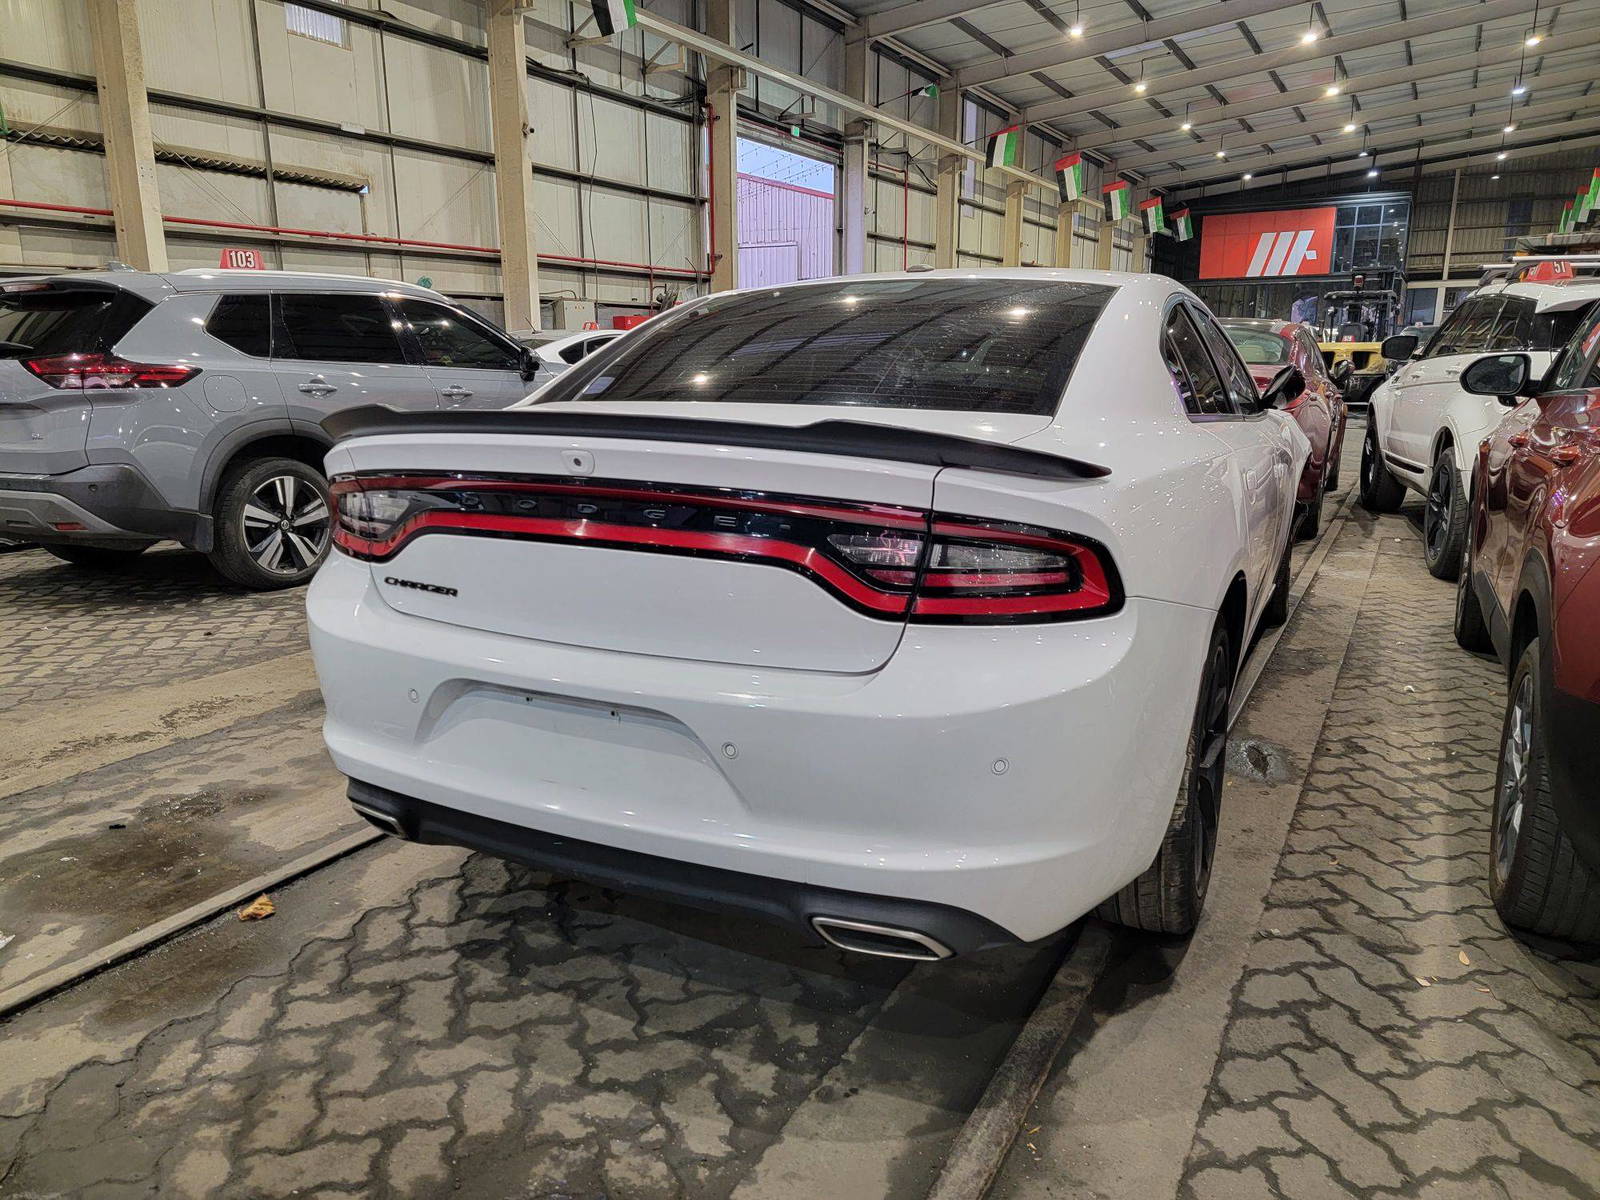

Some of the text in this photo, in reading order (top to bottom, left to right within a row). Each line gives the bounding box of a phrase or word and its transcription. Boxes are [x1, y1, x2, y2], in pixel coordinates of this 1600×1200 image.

[230, 250, 255, 268] 103
[462, 495, 737, 527] DODGE
[384, 576, 458, 597] CHARGER
